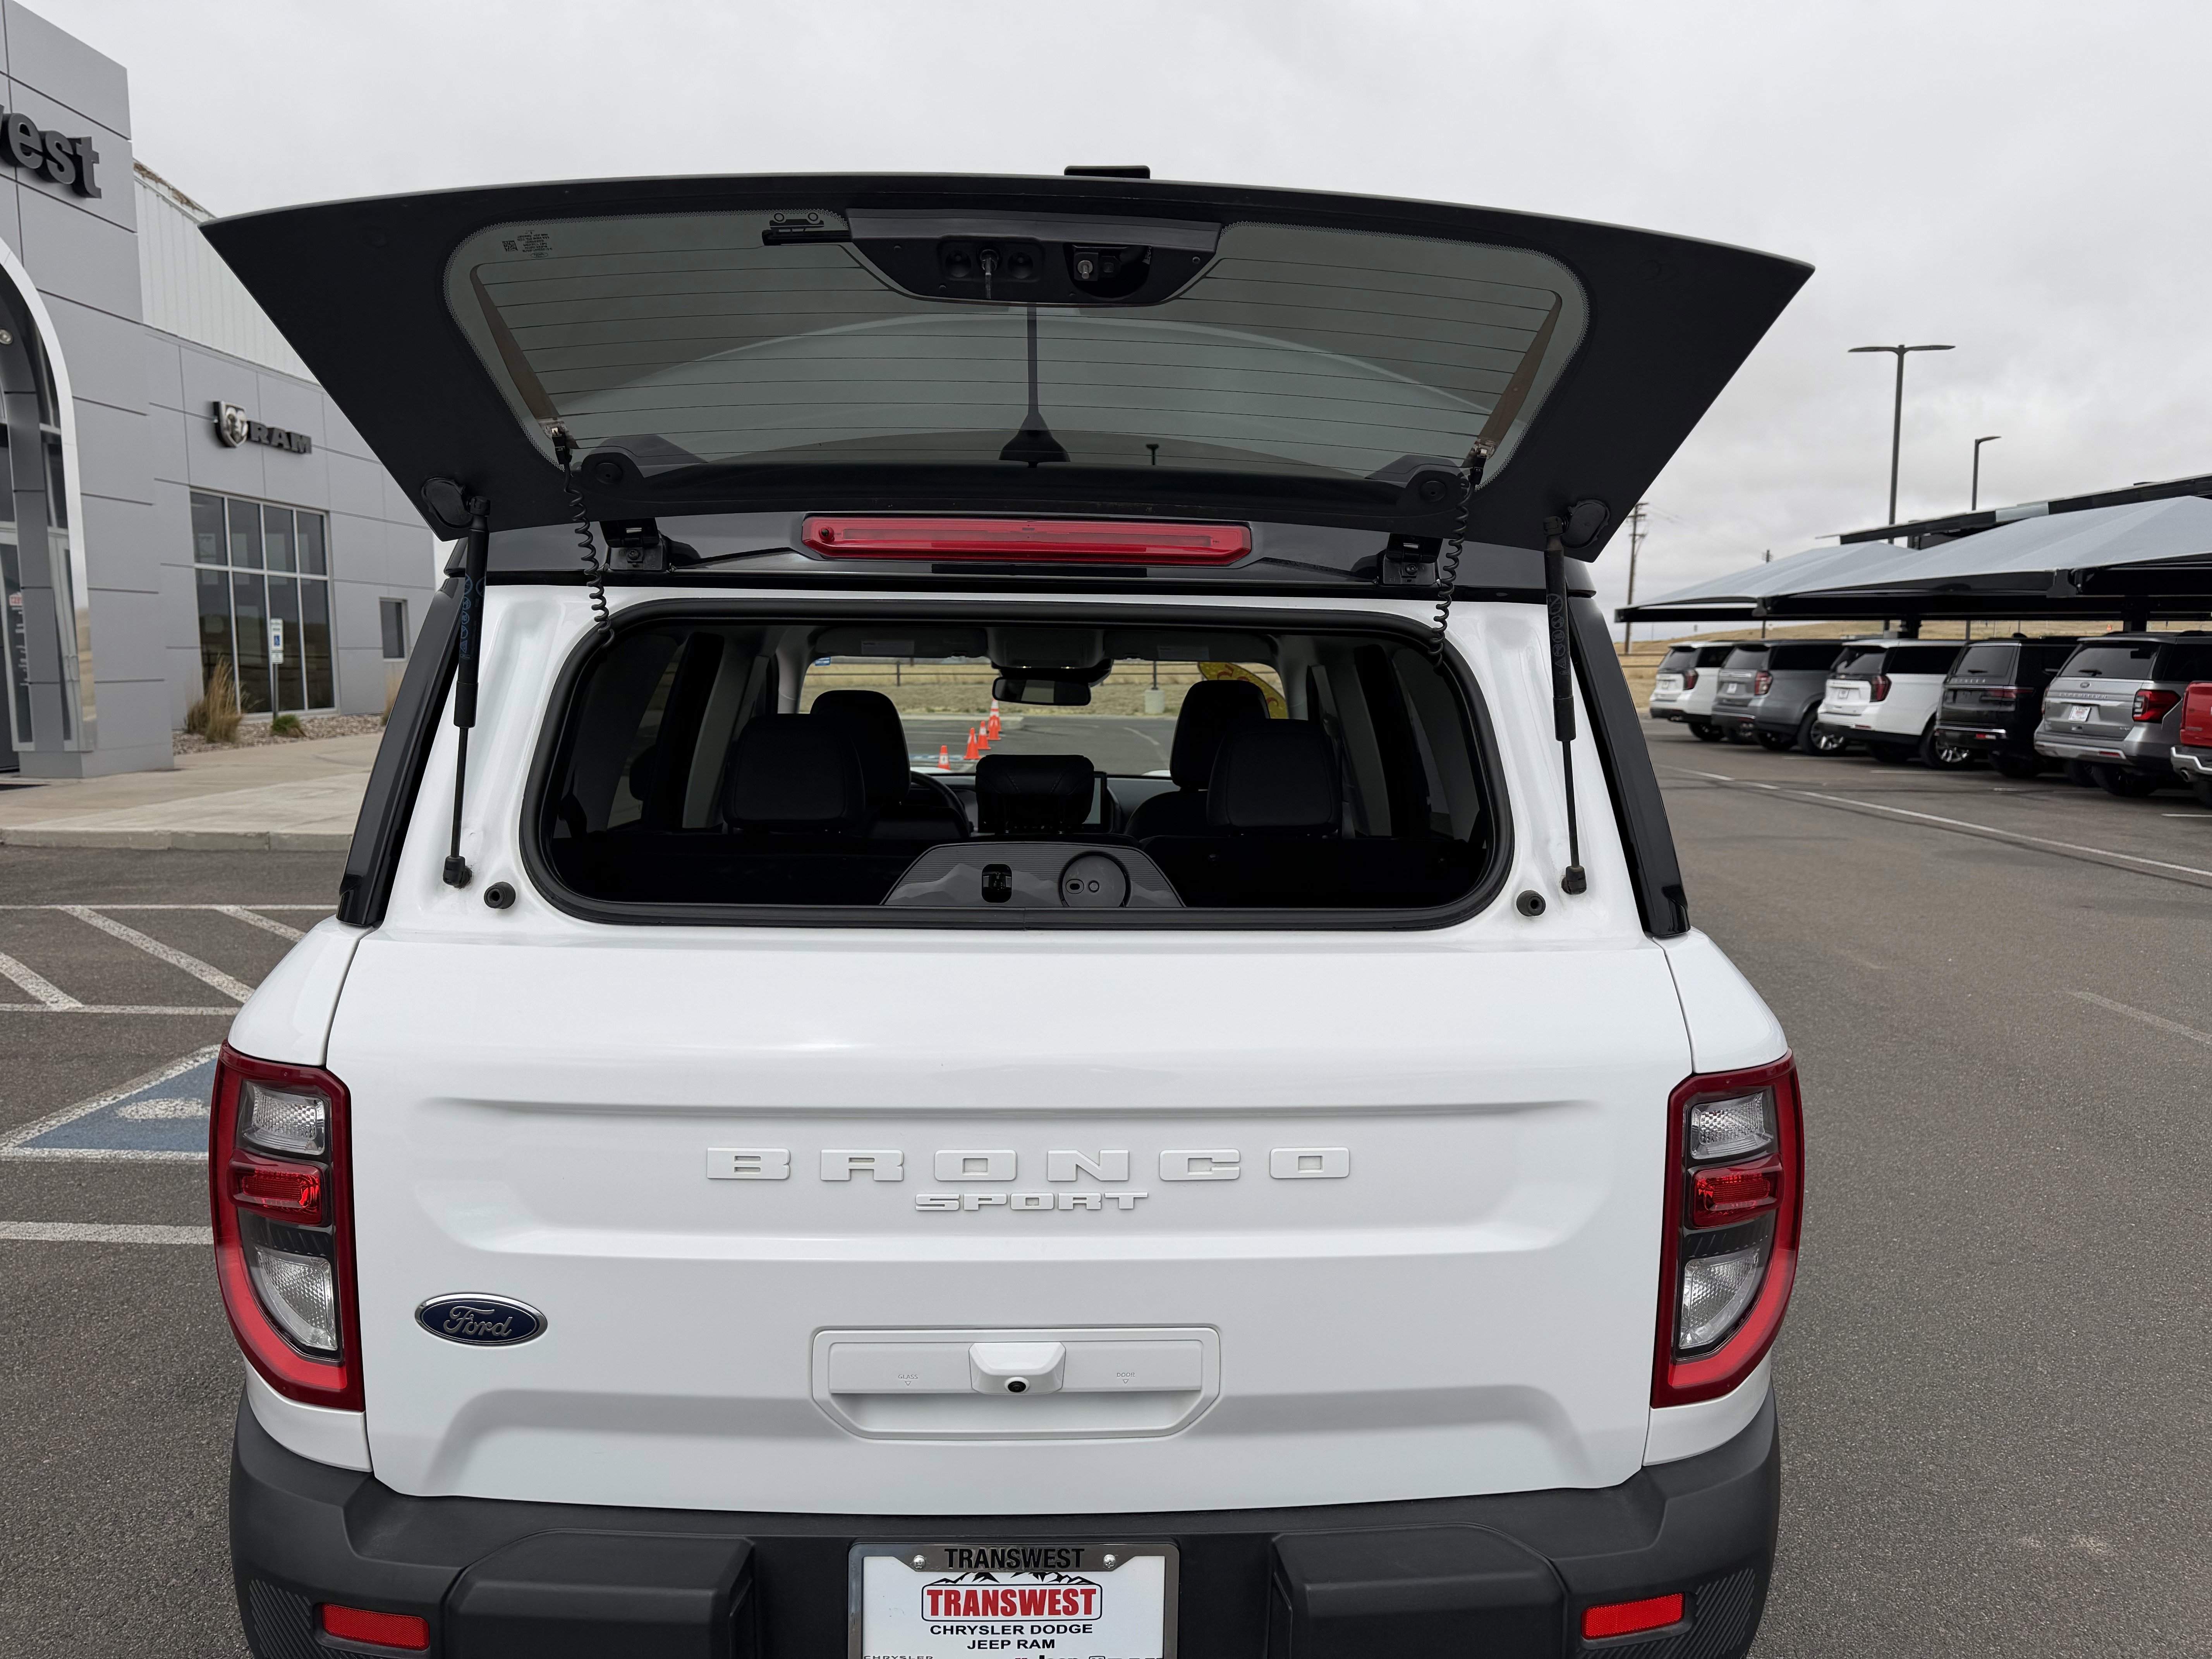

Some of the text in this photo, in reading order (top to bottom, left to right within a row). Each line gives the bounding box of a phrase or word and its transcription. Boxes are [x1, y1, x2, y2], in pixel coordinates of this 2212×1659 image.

[0, 104, 101, 199] est
[250, 420, 312, 454] RAM
[707, 1147, 1350, 1181] BRONCO
[915, 1192, 1148, 1211] SPORT
[443, 1305, 513, 1337] Ford
[944, 1548, 1085, 1569] TRANSWEST
[926, 1588, 1097, 1617] TRANSWEST
[929, 1624, 1093, 1635] CHRYSLER DODGE
[967, 1639, 1056, 1650] JEEP RAM
